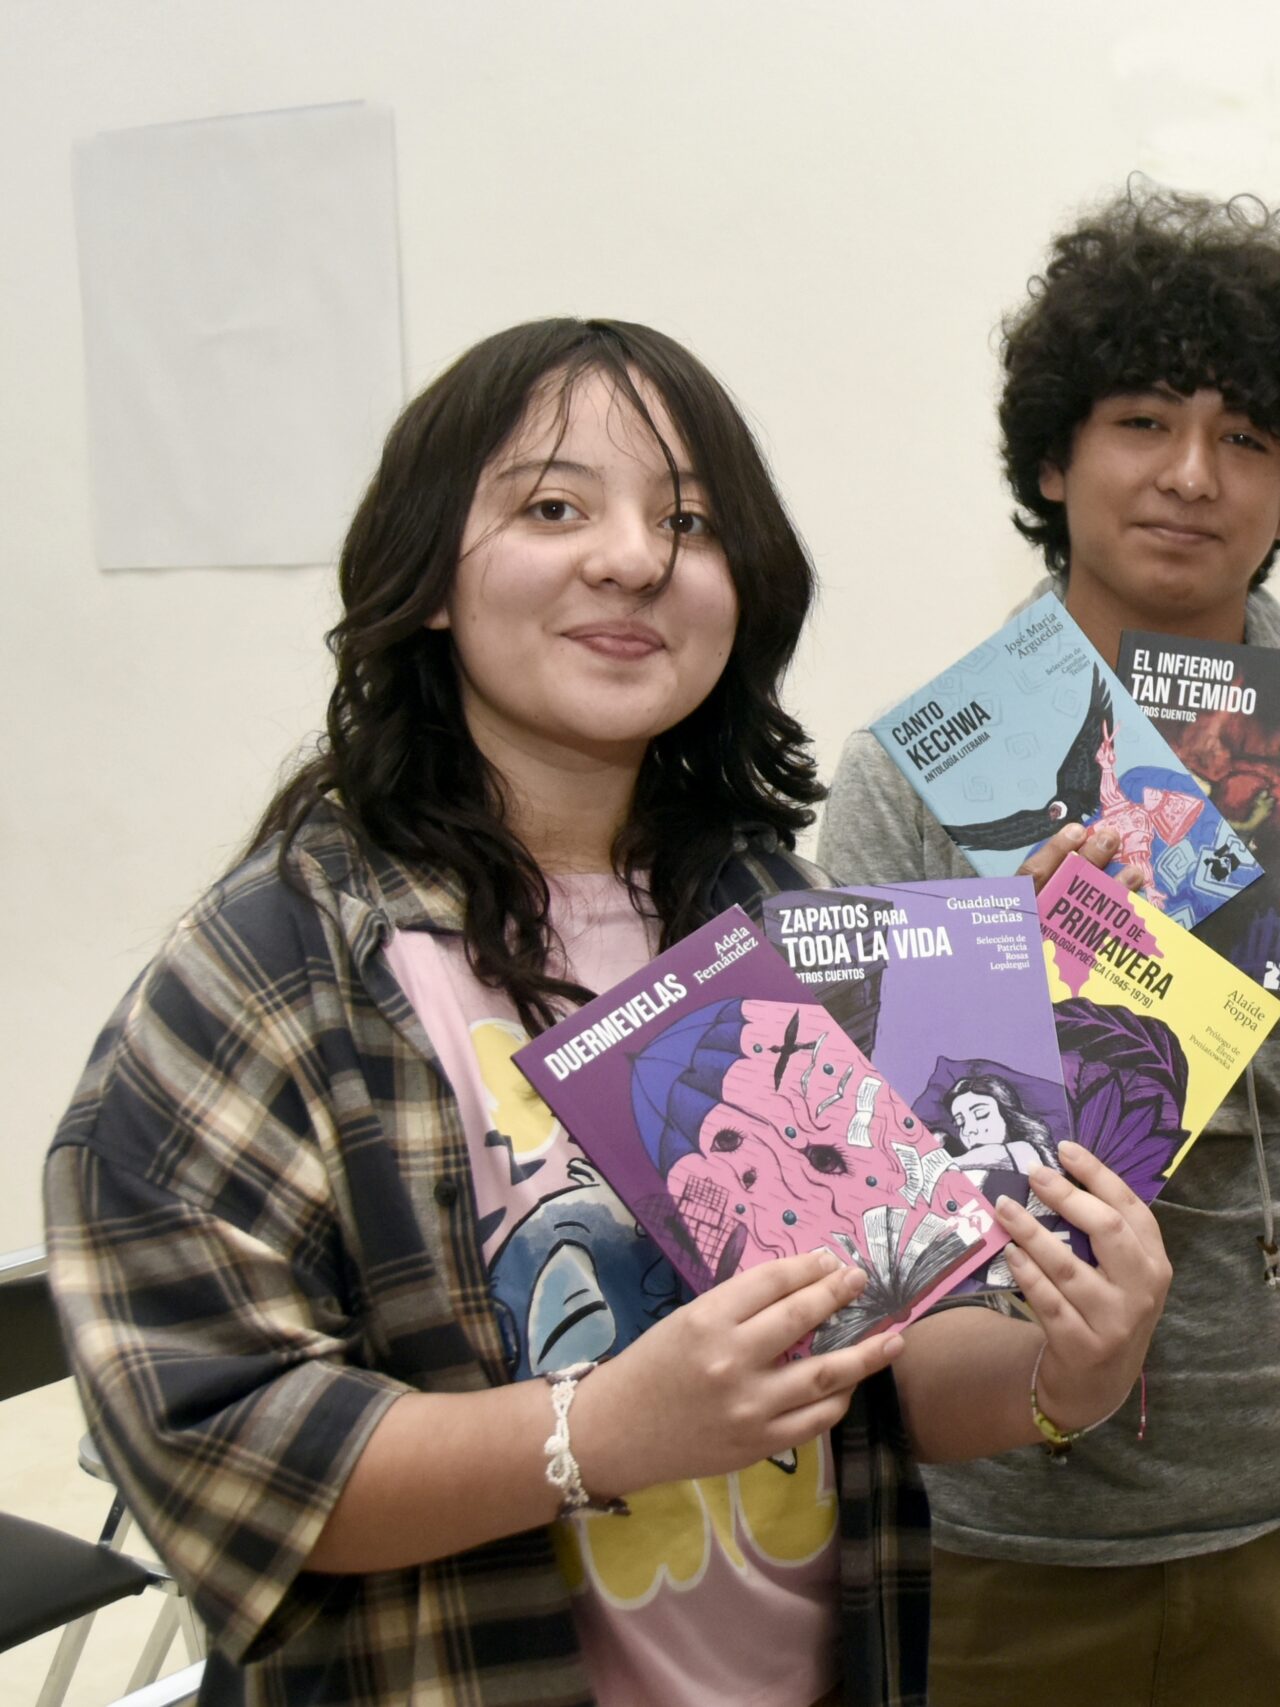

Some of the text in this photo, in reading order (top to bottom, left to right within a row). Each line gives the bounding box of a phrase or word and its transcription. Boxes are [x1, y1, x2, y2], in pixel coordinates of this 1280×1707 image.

[1004, 611, 1058, 656] José María
[1016, 621, 1064, 660] Arguedas
[1133, 649, 1234, 682] EL INFIERNO
[1130, 673, 1257, 715] TAN TEMIDO
[892, 700, 944, 747] CANTO
[1160, 708, 1197, 723] CUENTOS
[906, 700, 991, 771] KECHWA
[923, 731, 991, 784] ANTOLOGÍA LITERARIA
[779, 904, 908, 934] ZAPATOS PARA
[947, 895, 1021, 911] Guadalupe
[972, 911, 1022, 925] Dueñas
[1067, 876, 1145, 943] VIENTO DE
[713, 924, 751, 956] Adela
[782, 926, 953, 968] TODA LA VIDA
[976, 934, 1026, 945] Selección de
[997, 943, 1027, 952] Patricia
[1005, 952, 1029, 960] Rosas
[1046, 898, 1174, 1000] PRIMAVERA
[692, 936, 759, 985] Fernández
[825, 968, 865, 982] CUENTOS
[1074, 947, 1107, 976] POÉTICA
[1223, 1000, 1259, 1031] Foppa
[1227, 989, 1266, 1022] Alaíde
[543, 973, 688, 1082] DUERMEVELAS
[1205, 1026, 1241, 1056] Prólogo de
[1189, 1034, 1232, 1070] Poniatowska
[1215, 1045, 1236, 1064] Elena
